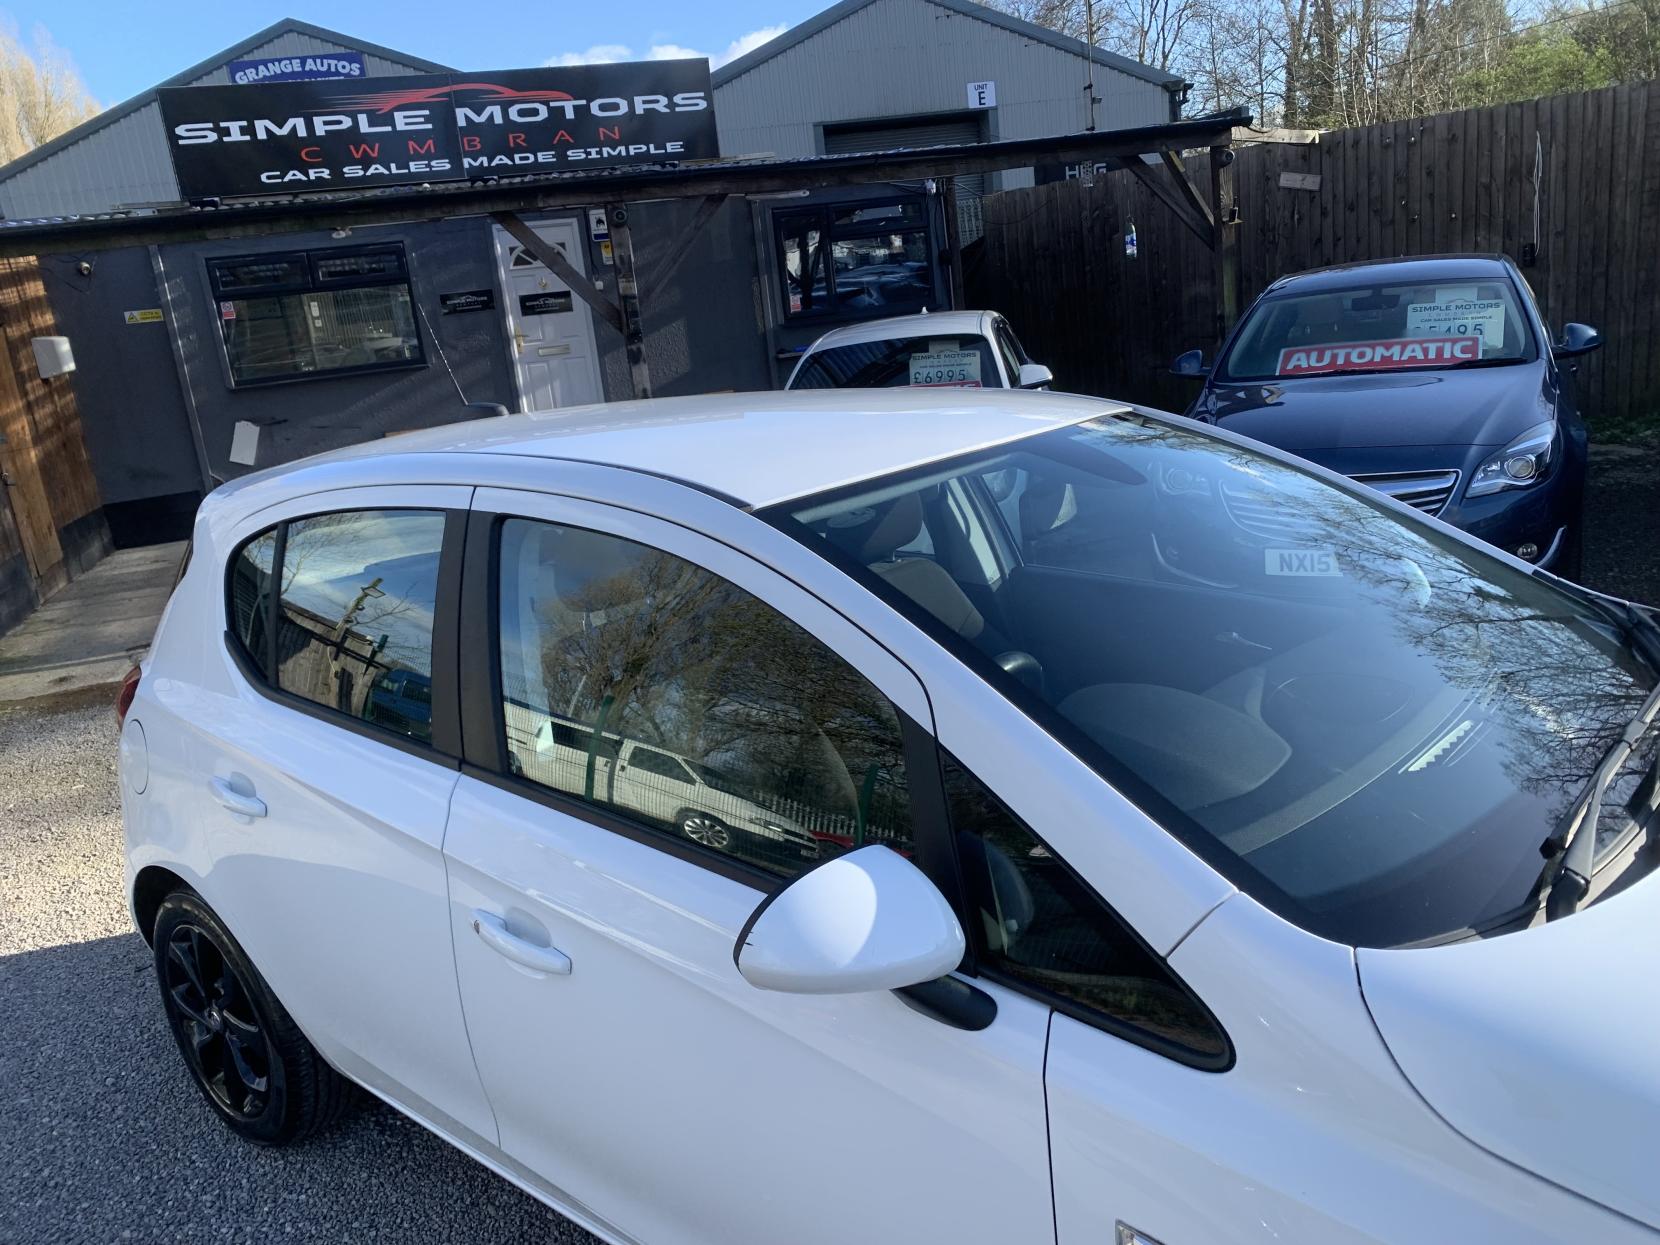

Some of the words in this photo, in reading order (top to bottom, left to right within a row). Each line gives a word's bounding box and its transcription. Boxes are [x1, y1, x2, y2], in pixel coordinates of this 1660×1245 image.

[235, 59, 302, 84] GRANGE
[305, 58, 360, 76] AUTOS
[974, 83, 988, 91] UNIT
[978, 91, 986, 106] E
[174, 110, 433, 144] SIMPLE
[455, 92, 708, 127] MOTORS
[301, 126, 622, 162] CWMBRAN
[260, 168, 332, 183] CAR
[343, 159, 451, 178] SALES
[463, 151, 557, 169] MADE
[567, 141, 685, 160] SIMPLE
[1455, 302, 1501, 310] MOTORS
[1286, 341, 1473, 369] AUTOMATIC
[913, 369, 966, 384] £6995
[1279, 553, 1331, 573] NX15
